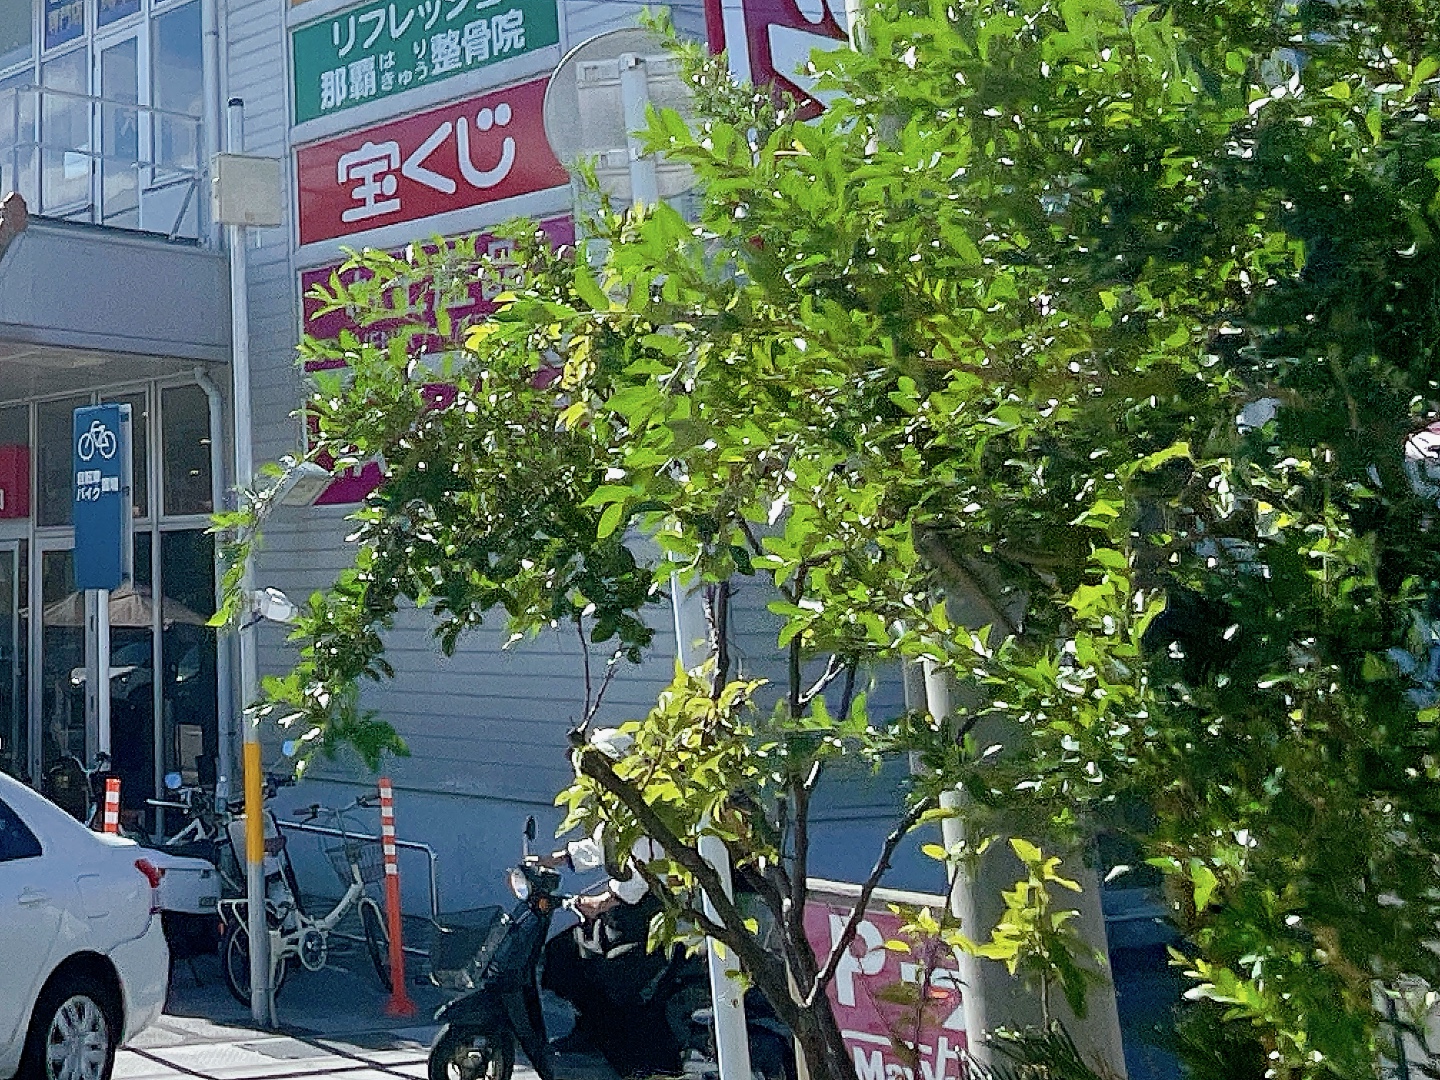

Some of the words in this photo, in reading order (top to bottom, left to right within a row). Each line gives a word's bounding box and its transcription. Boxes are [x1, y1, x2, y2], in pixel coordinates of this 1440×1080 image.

[337, 103, 516, 223] 宝くじ
[76, 487, 101, 502] バイク
